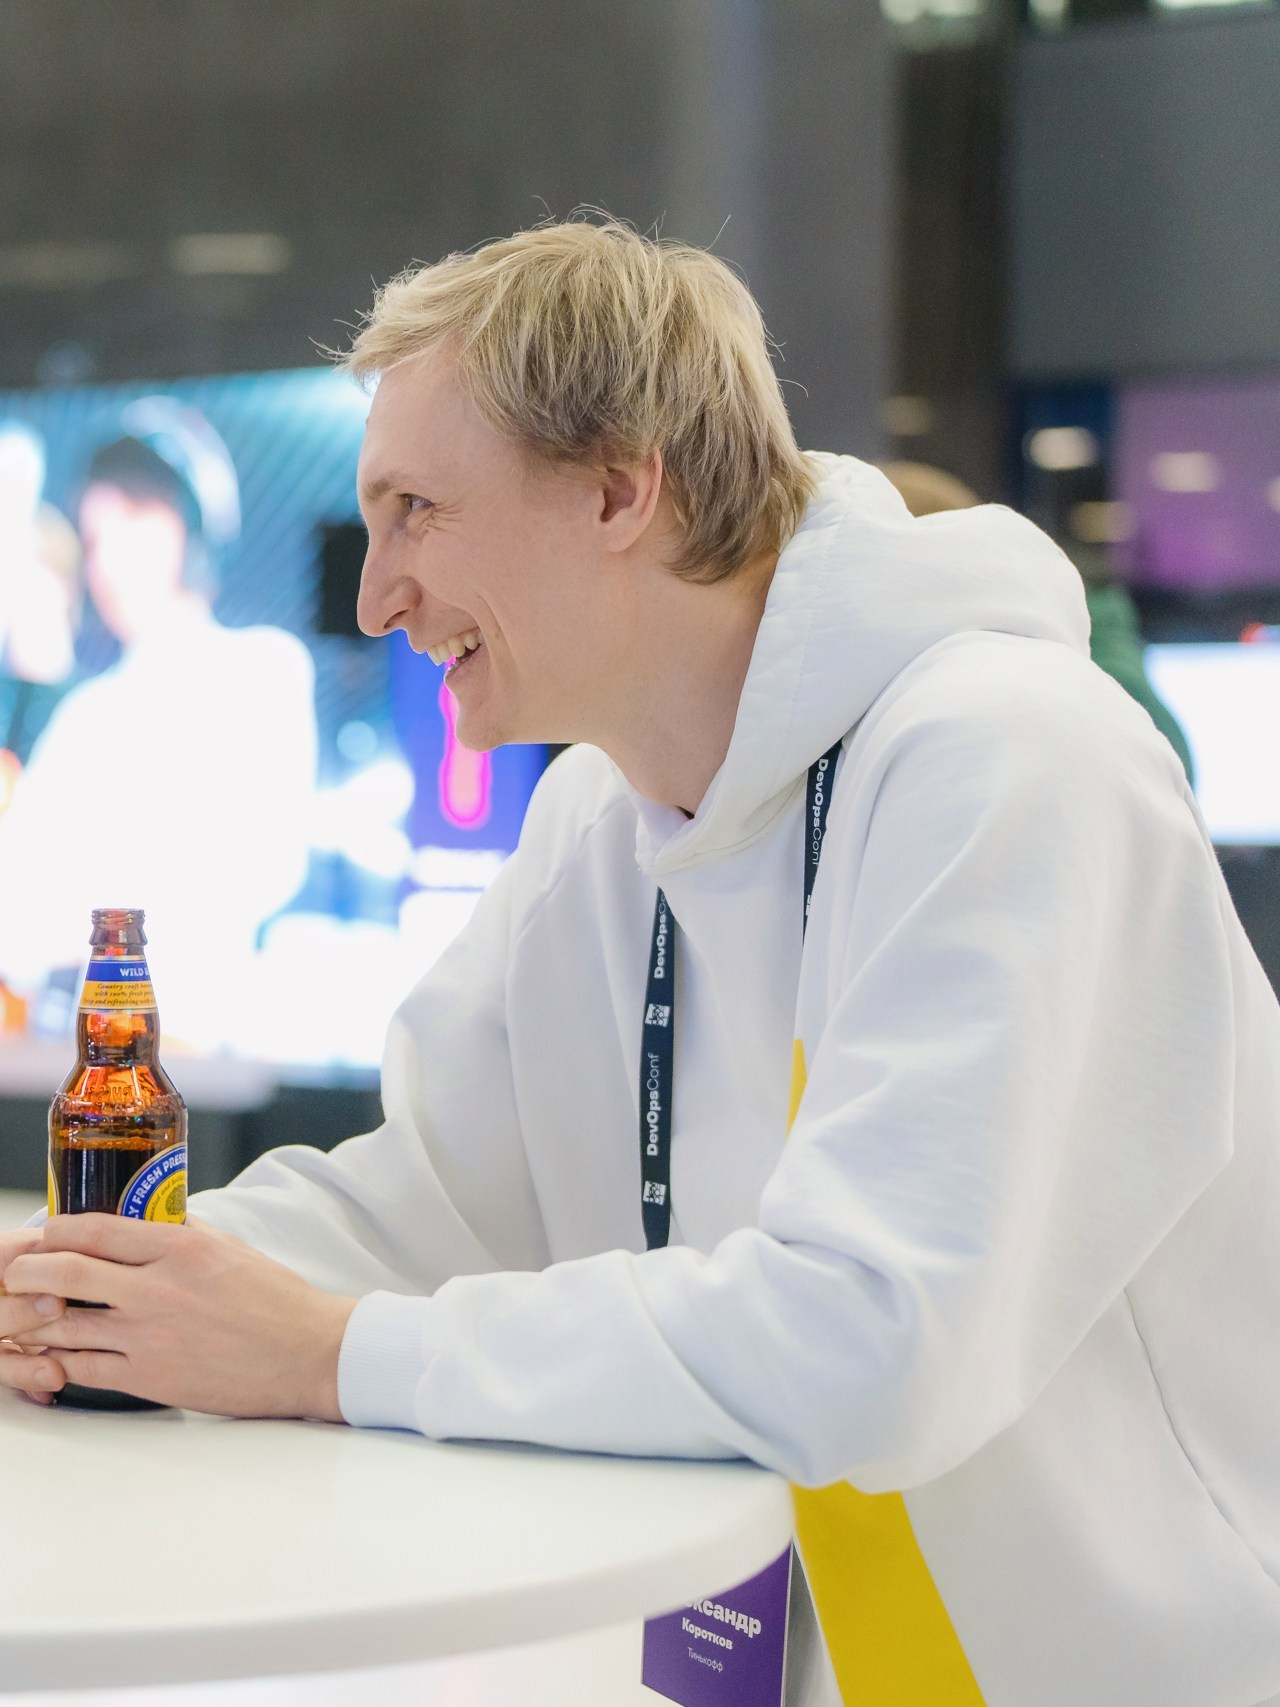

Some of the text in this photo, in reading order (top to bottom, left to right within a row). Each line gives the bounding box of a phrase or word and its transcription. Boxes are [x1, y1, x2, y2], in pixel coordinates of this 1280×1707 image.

[653, 893, 668, 979] DevOpsCo
[120, 968, 144, 977] WILD
[107, 999, 139, 1007] refreshing
[646, 1052, 661, 1156] DevOpsConf
[132, 1166, 163, 1205] FRESH
[682, 1617, 733, 1650] Коротков
[687, 1646, 724, 1673] Тинькофф
